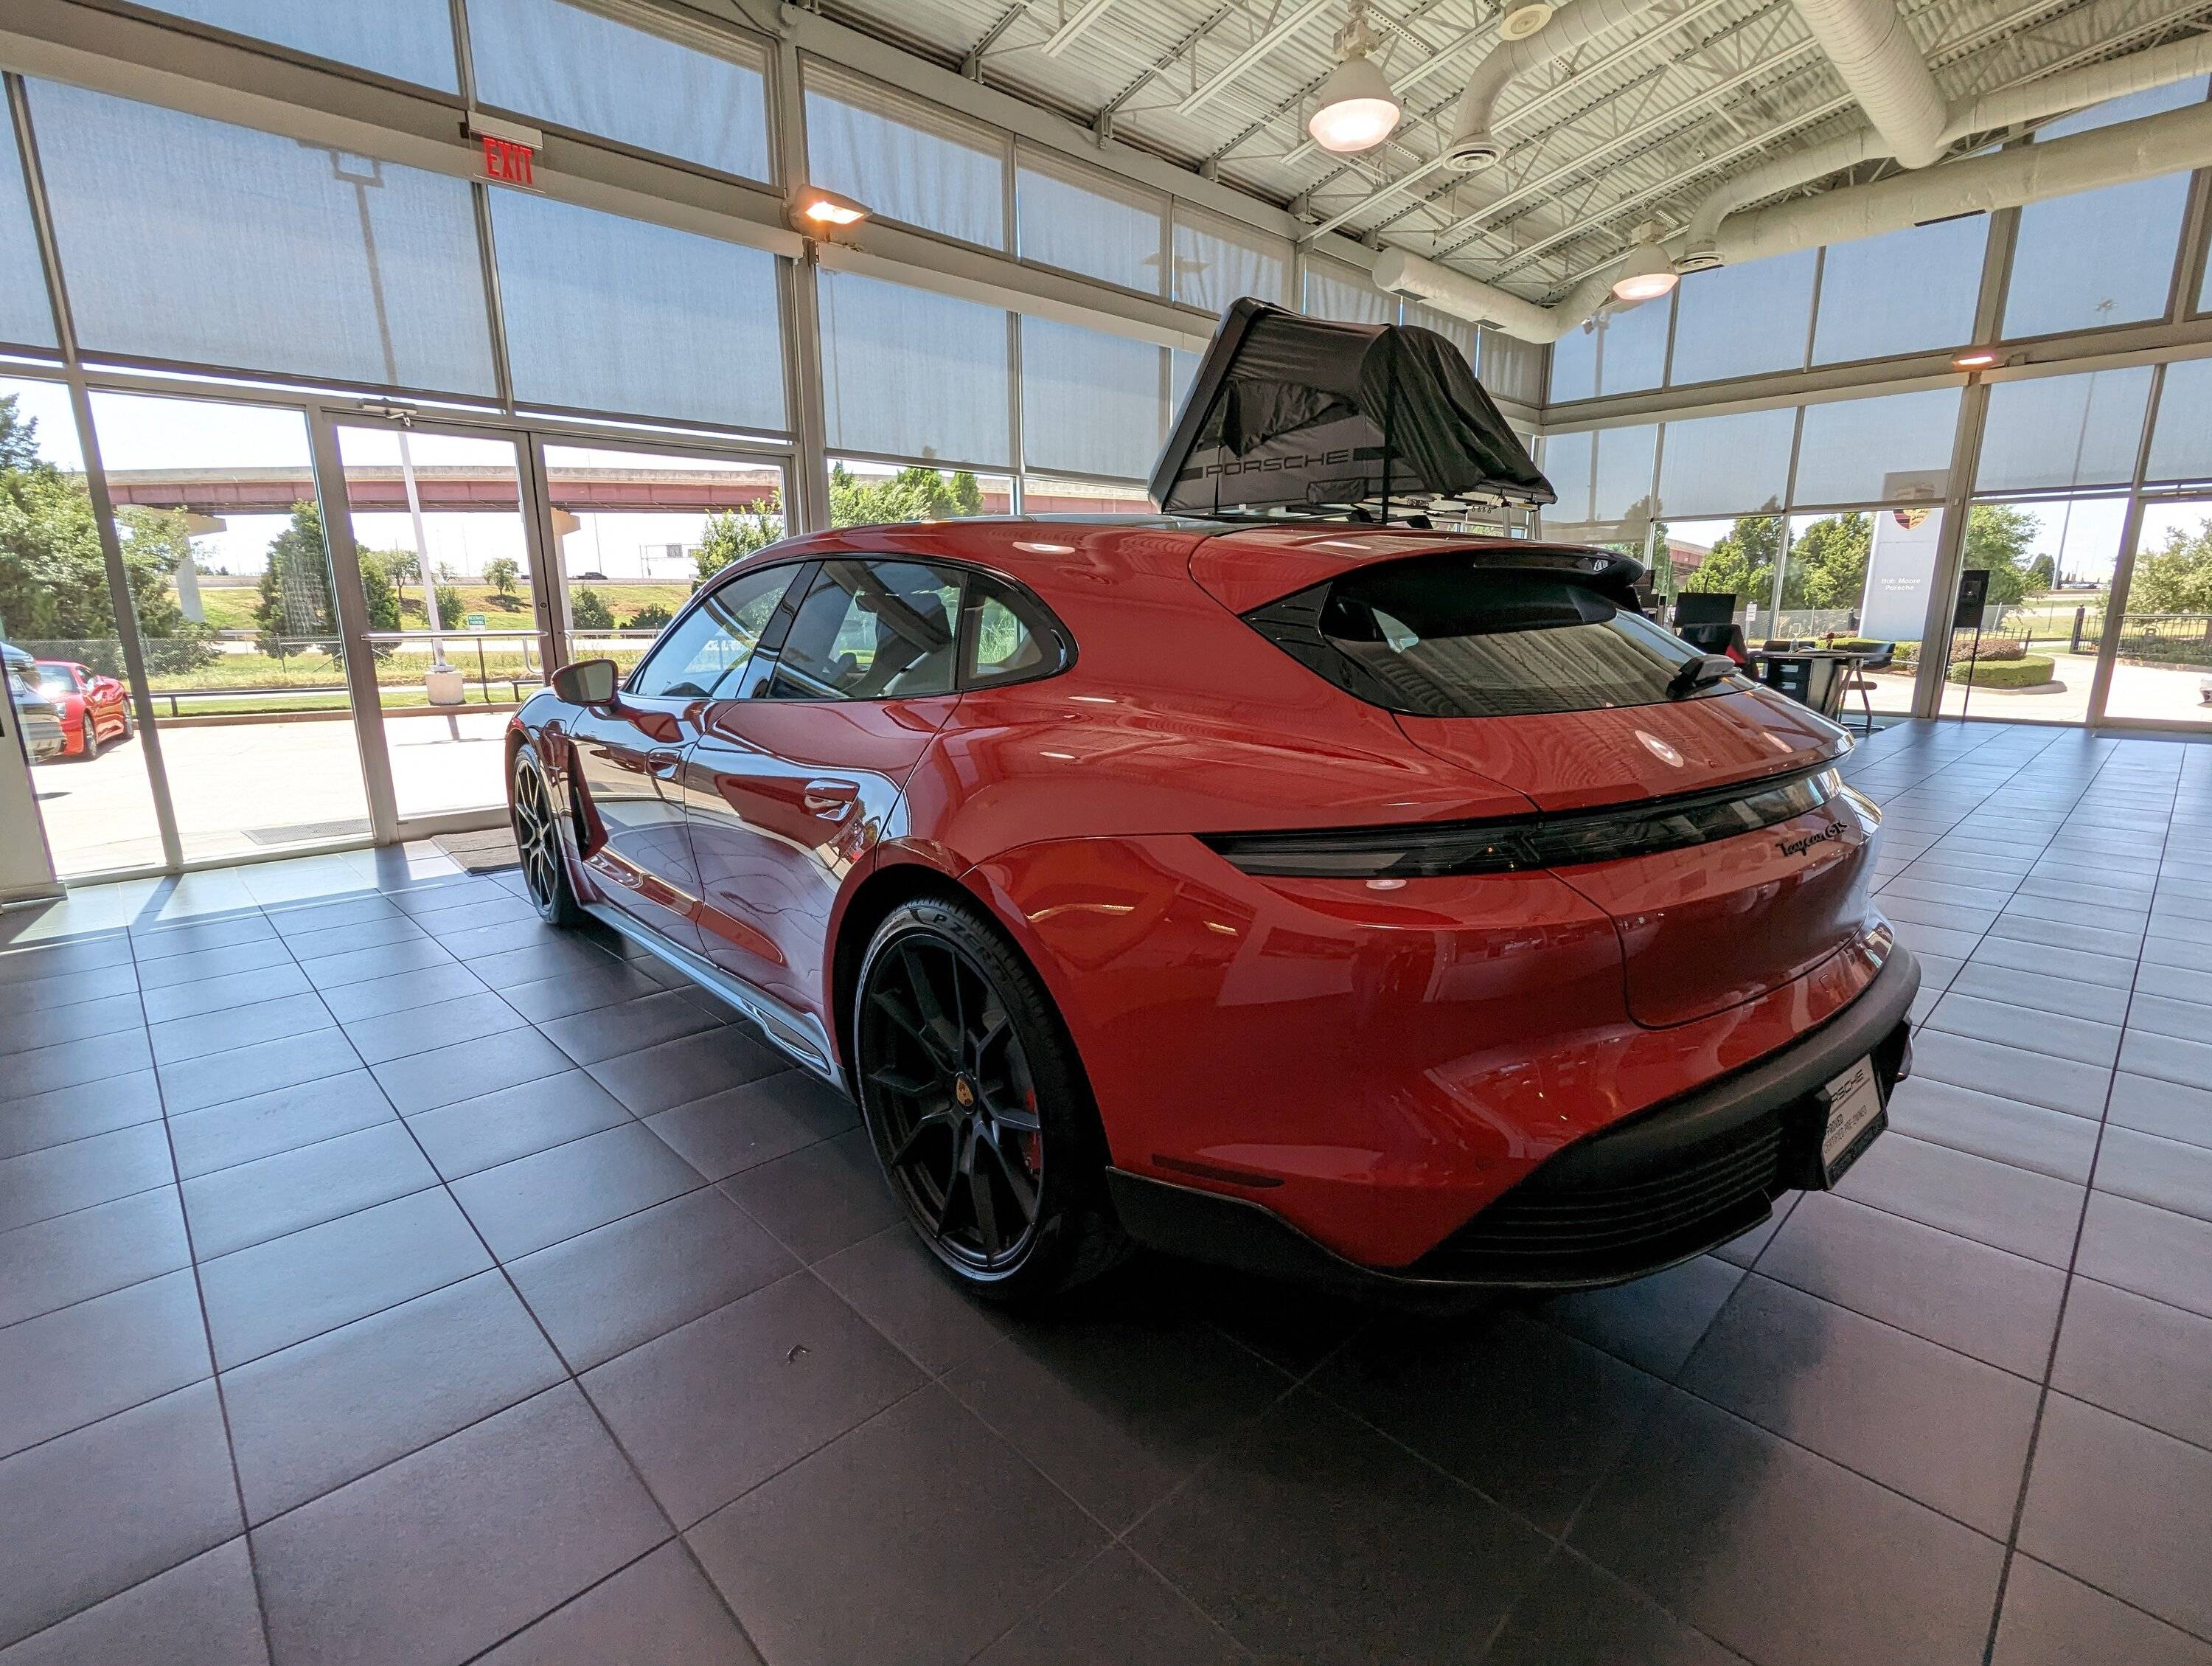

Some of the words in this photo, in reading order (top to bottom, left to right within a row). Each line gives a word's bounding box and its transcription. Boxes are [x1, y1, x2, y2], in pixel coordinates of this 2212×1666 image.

[484, 137, 532, 185] EXIT
[1206, 449, 1349, 478] PORSCHE
[932, 913, 947, 923] P
[1831, 1069, 1864, 1103] RSCHE
